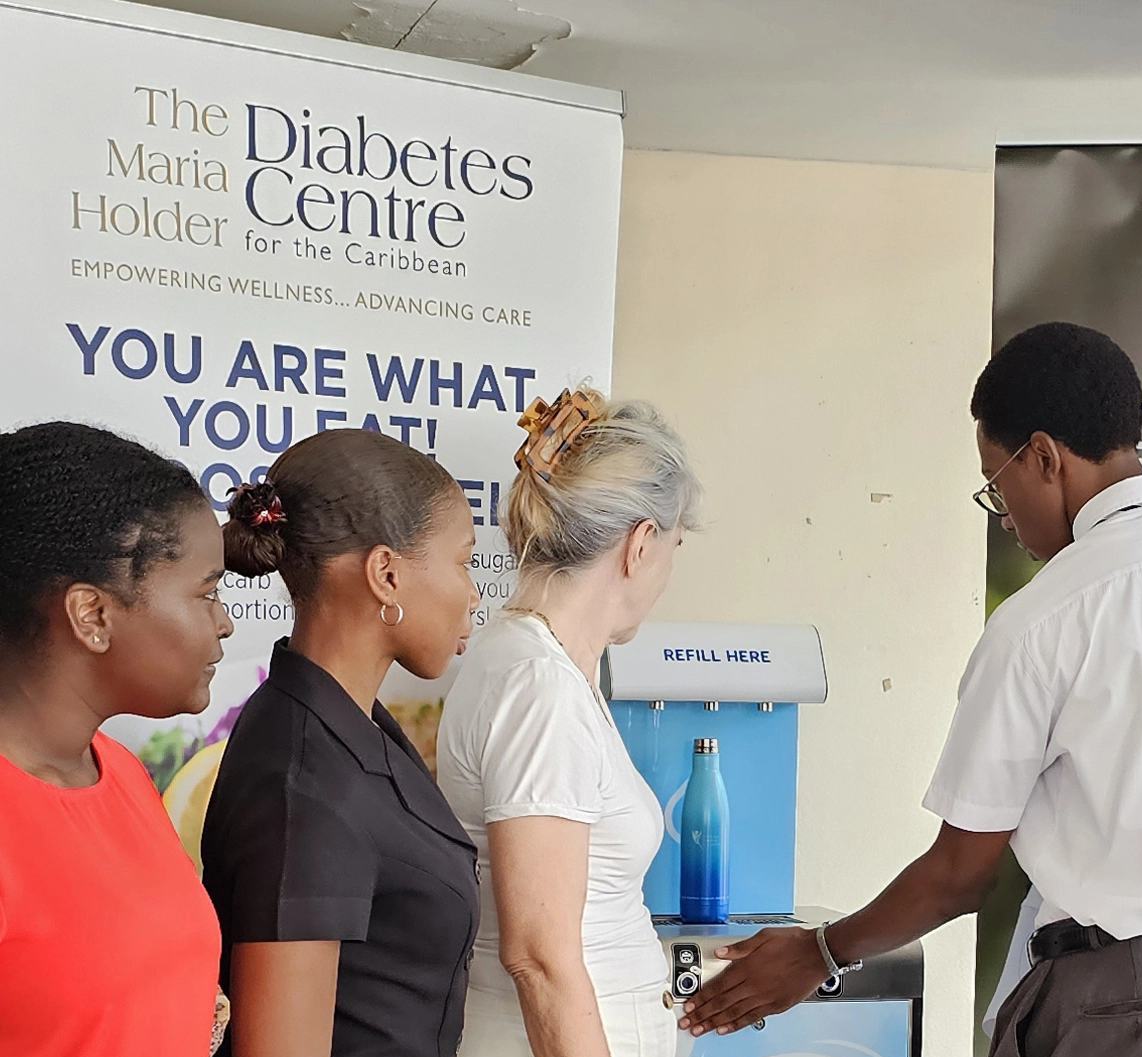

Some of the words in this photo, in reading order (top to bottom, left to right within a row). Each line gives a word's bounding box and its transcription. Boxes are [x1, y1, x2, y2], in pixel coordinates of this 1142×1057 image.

[134, 86, 229, 137] The
[106, 139, 228, 192] Maria
[245, 103, 533, 200] Diabetes
[72, 191, 228, 247] Holder
[245, 167, 466, 248] Centre
[245, 230, 282, 254] for
[293, 237, 332, 261] the
[345, 243, 467, 278] Caribbean
[71, 259, 222, 292] EMPOWERING
[355, 292, 474, 321] ADVANCING
[482, 307, 532, 327] CARE
[65, 323, 202, 384] YOU
[225, 340, 346, 397] ARE
[366, 353, 536, 413] WHAT
[163, 396, 292, 453] YOU
[664, 648, 721, 662] REFILL
[726, 649, 771, 663] HERE
